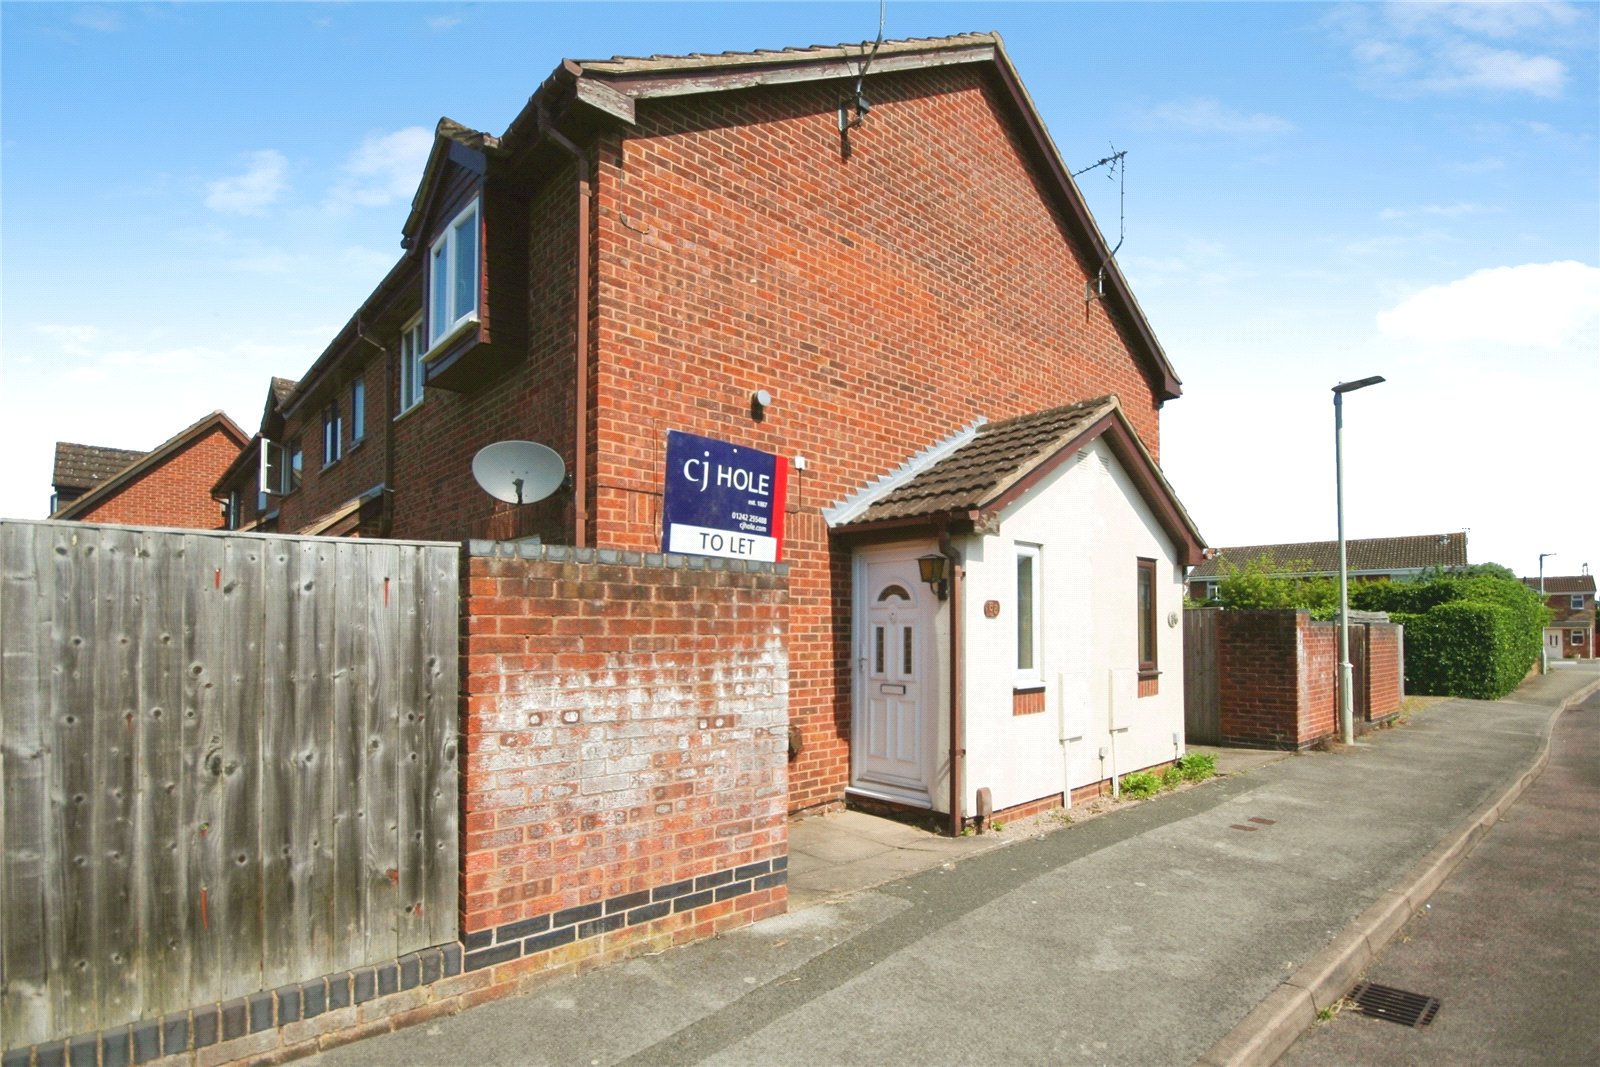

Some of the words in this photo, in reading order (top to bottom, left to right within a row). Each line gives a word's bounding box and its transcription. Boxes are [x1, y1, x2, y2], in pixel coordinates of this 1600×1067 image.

[683, 451, 710, 492] cj
[717, 464, 770, 496] HOLE
[731, 511, 748, 521] 01242
[700, 532, 724, 552] TO
[730, 536, 755, 555] LET
